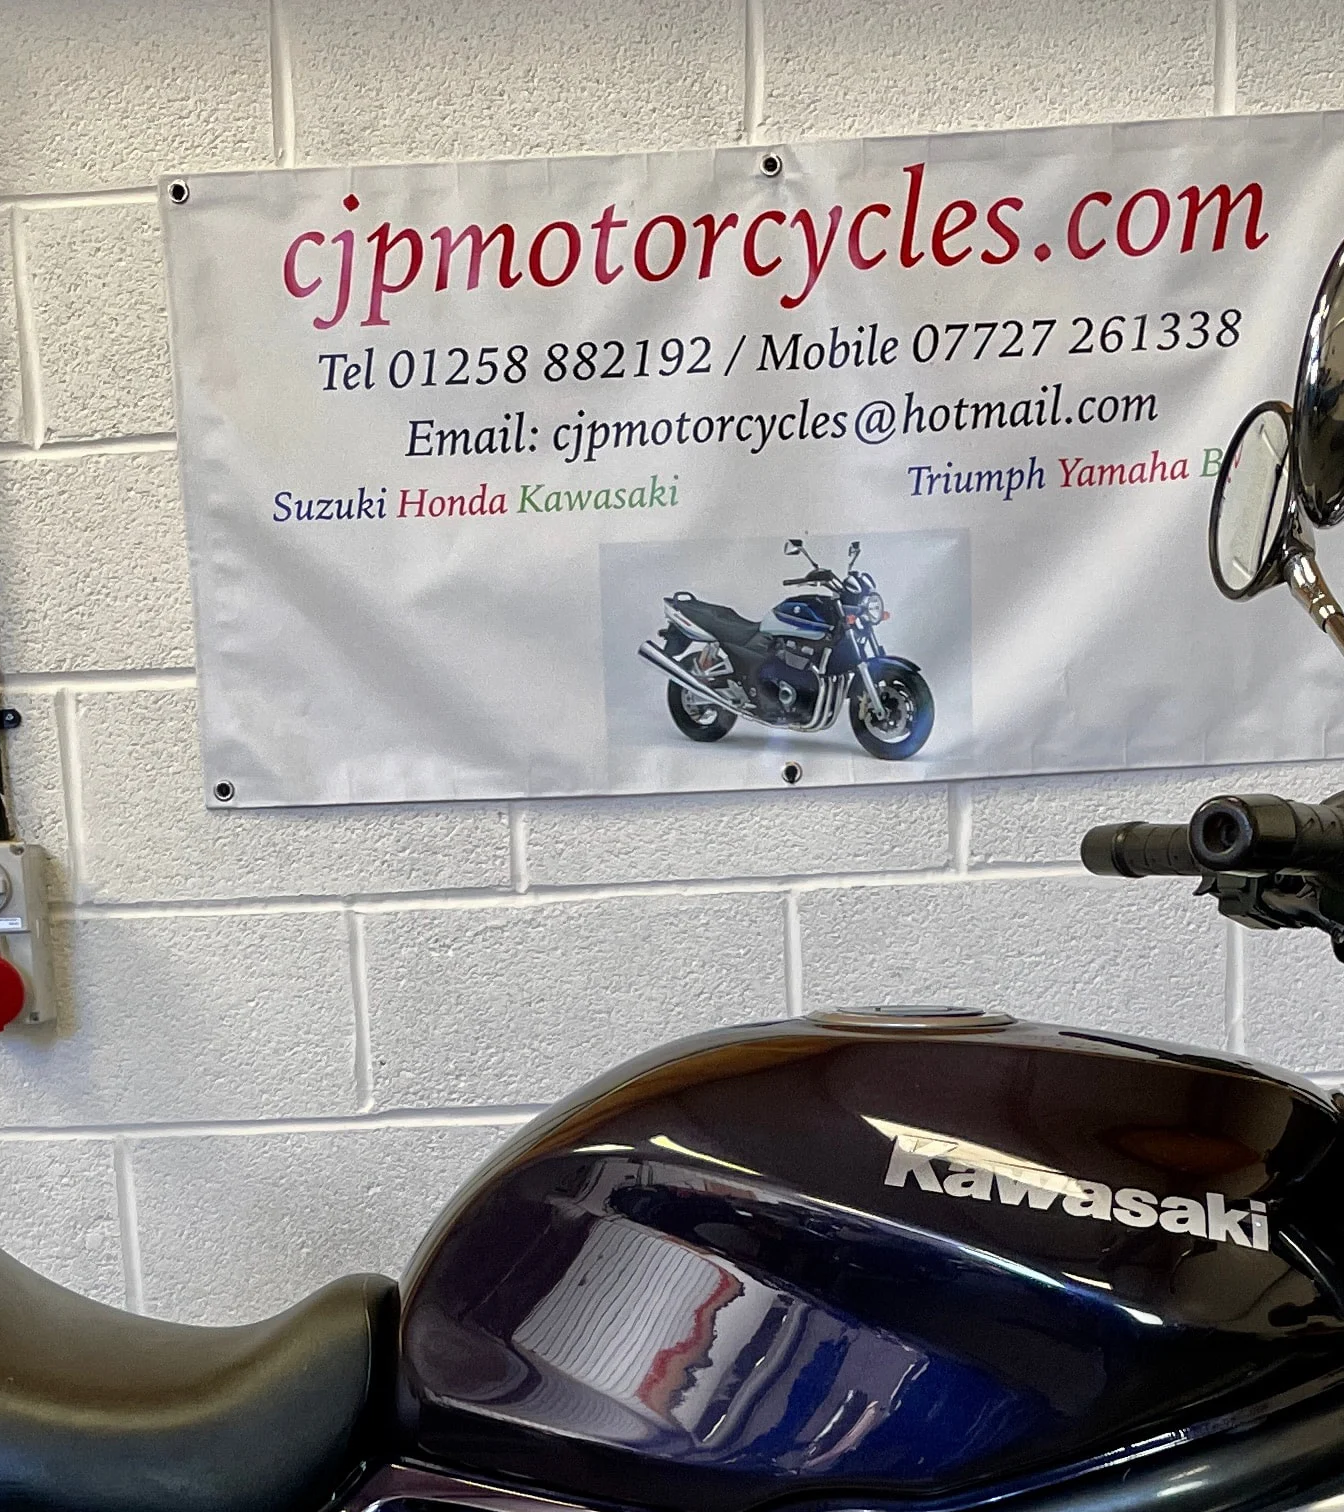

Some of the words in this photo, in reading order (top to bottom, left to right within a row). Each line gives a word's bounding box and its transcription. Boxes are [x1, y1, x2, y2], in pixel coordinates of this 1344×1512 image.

[283, 162, 1270, 330] cjpmotorcycles.com
[318, 346, 376, 391] Tel
[388, 344, 529, 389] 01258
[543, 336, 712, 383] 882192
[755, 322, 899, 372] Mobile
[912, 318, 1057, 364] 07727
[1067, 308, 1242, 355] 261338
[404, 410, 539, 457] Email:
[552, 382, 1159, 464] cjpmotorcycles@hotmail.com
[272, 486, 387, 523] Suzuki
[396, 482, 509, 519] Honda
[516, 474, 679, 514] Kawasaki
[907, 455, 1046, 502] Triumph
[1057, 449, 1190, 488] Yamaha
[884, 1134, 1270, 1252] Kawasaki
